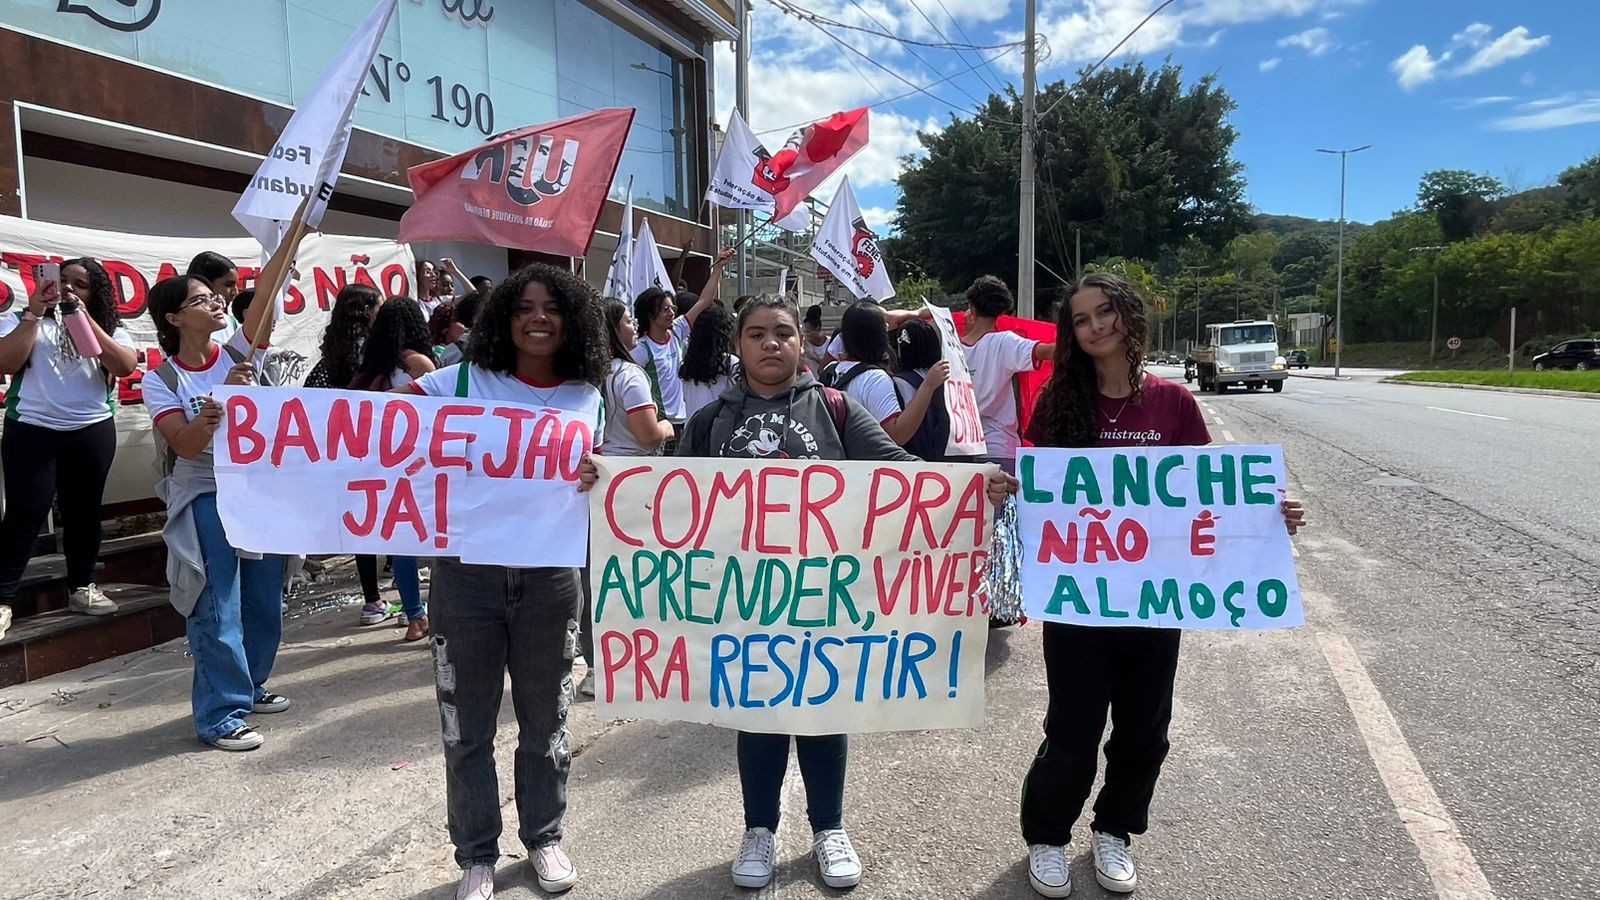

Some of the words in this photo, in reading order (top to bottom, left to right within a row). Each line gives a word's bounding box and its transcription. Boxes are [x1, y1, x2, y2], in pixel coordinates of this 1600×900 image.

[427, 75, 494, 136] 190
[226, 394, 592, 482] BANDEJÃO
[1100, 428, 1161, 443] inistração
[343, 457, 448, 549] JÁ!
[604, 464, 846, 555] COMER
[862, 467, 985, 552] PRA
[1020, 454, 1277, 507] LANCHE
[1037, 508, 1149, 563] NÃO
[1191, 510, 1217, 555] É
[595, 549, 876, 631] APRENDER,
[1044, 575, 1288, 627] ALMOÇO
[601, 629, 690, 703] PRA
